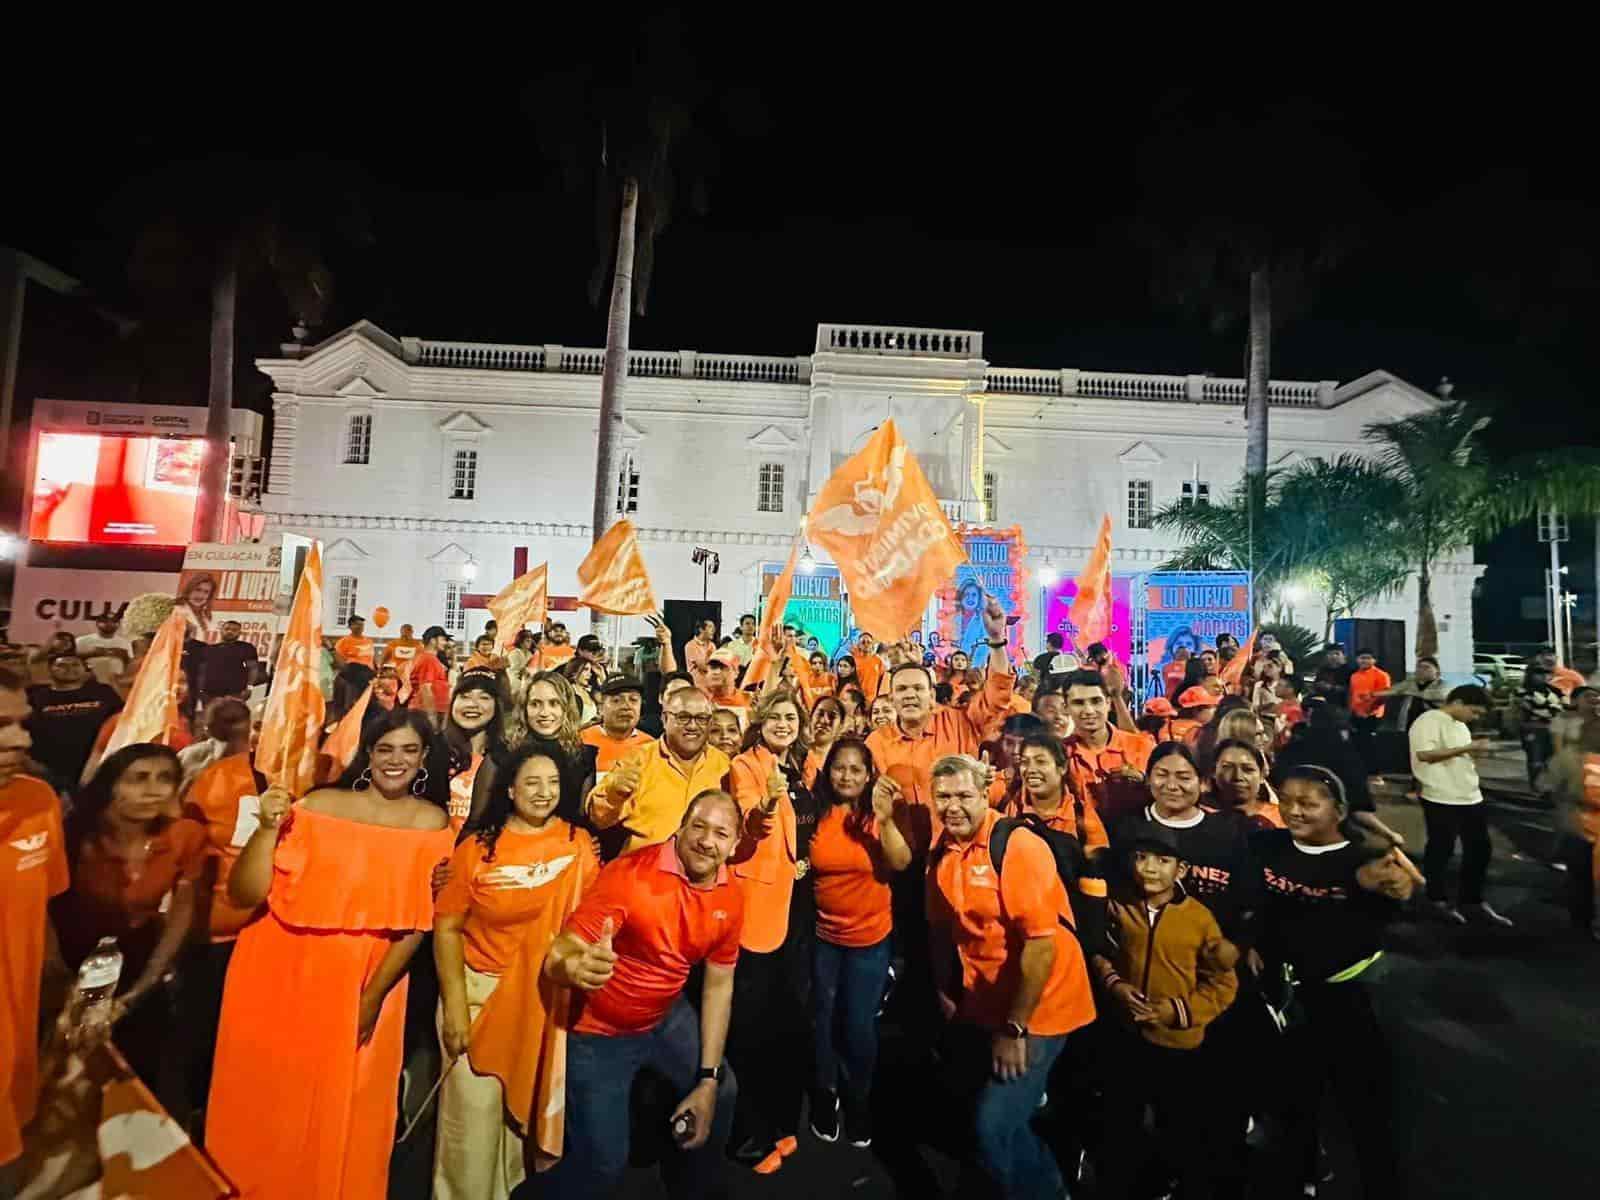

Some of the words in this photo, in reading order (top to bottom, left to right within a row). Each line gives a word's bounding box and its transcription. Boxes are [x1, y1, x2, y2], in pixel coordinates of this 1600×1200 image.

[971, 543, 1008, 561] NUEVO
[1162, 586, 1178, 608] LO
[1183, 586, 1232, 608] NUEVO
[800, 608, 839, 624] MARTOS
